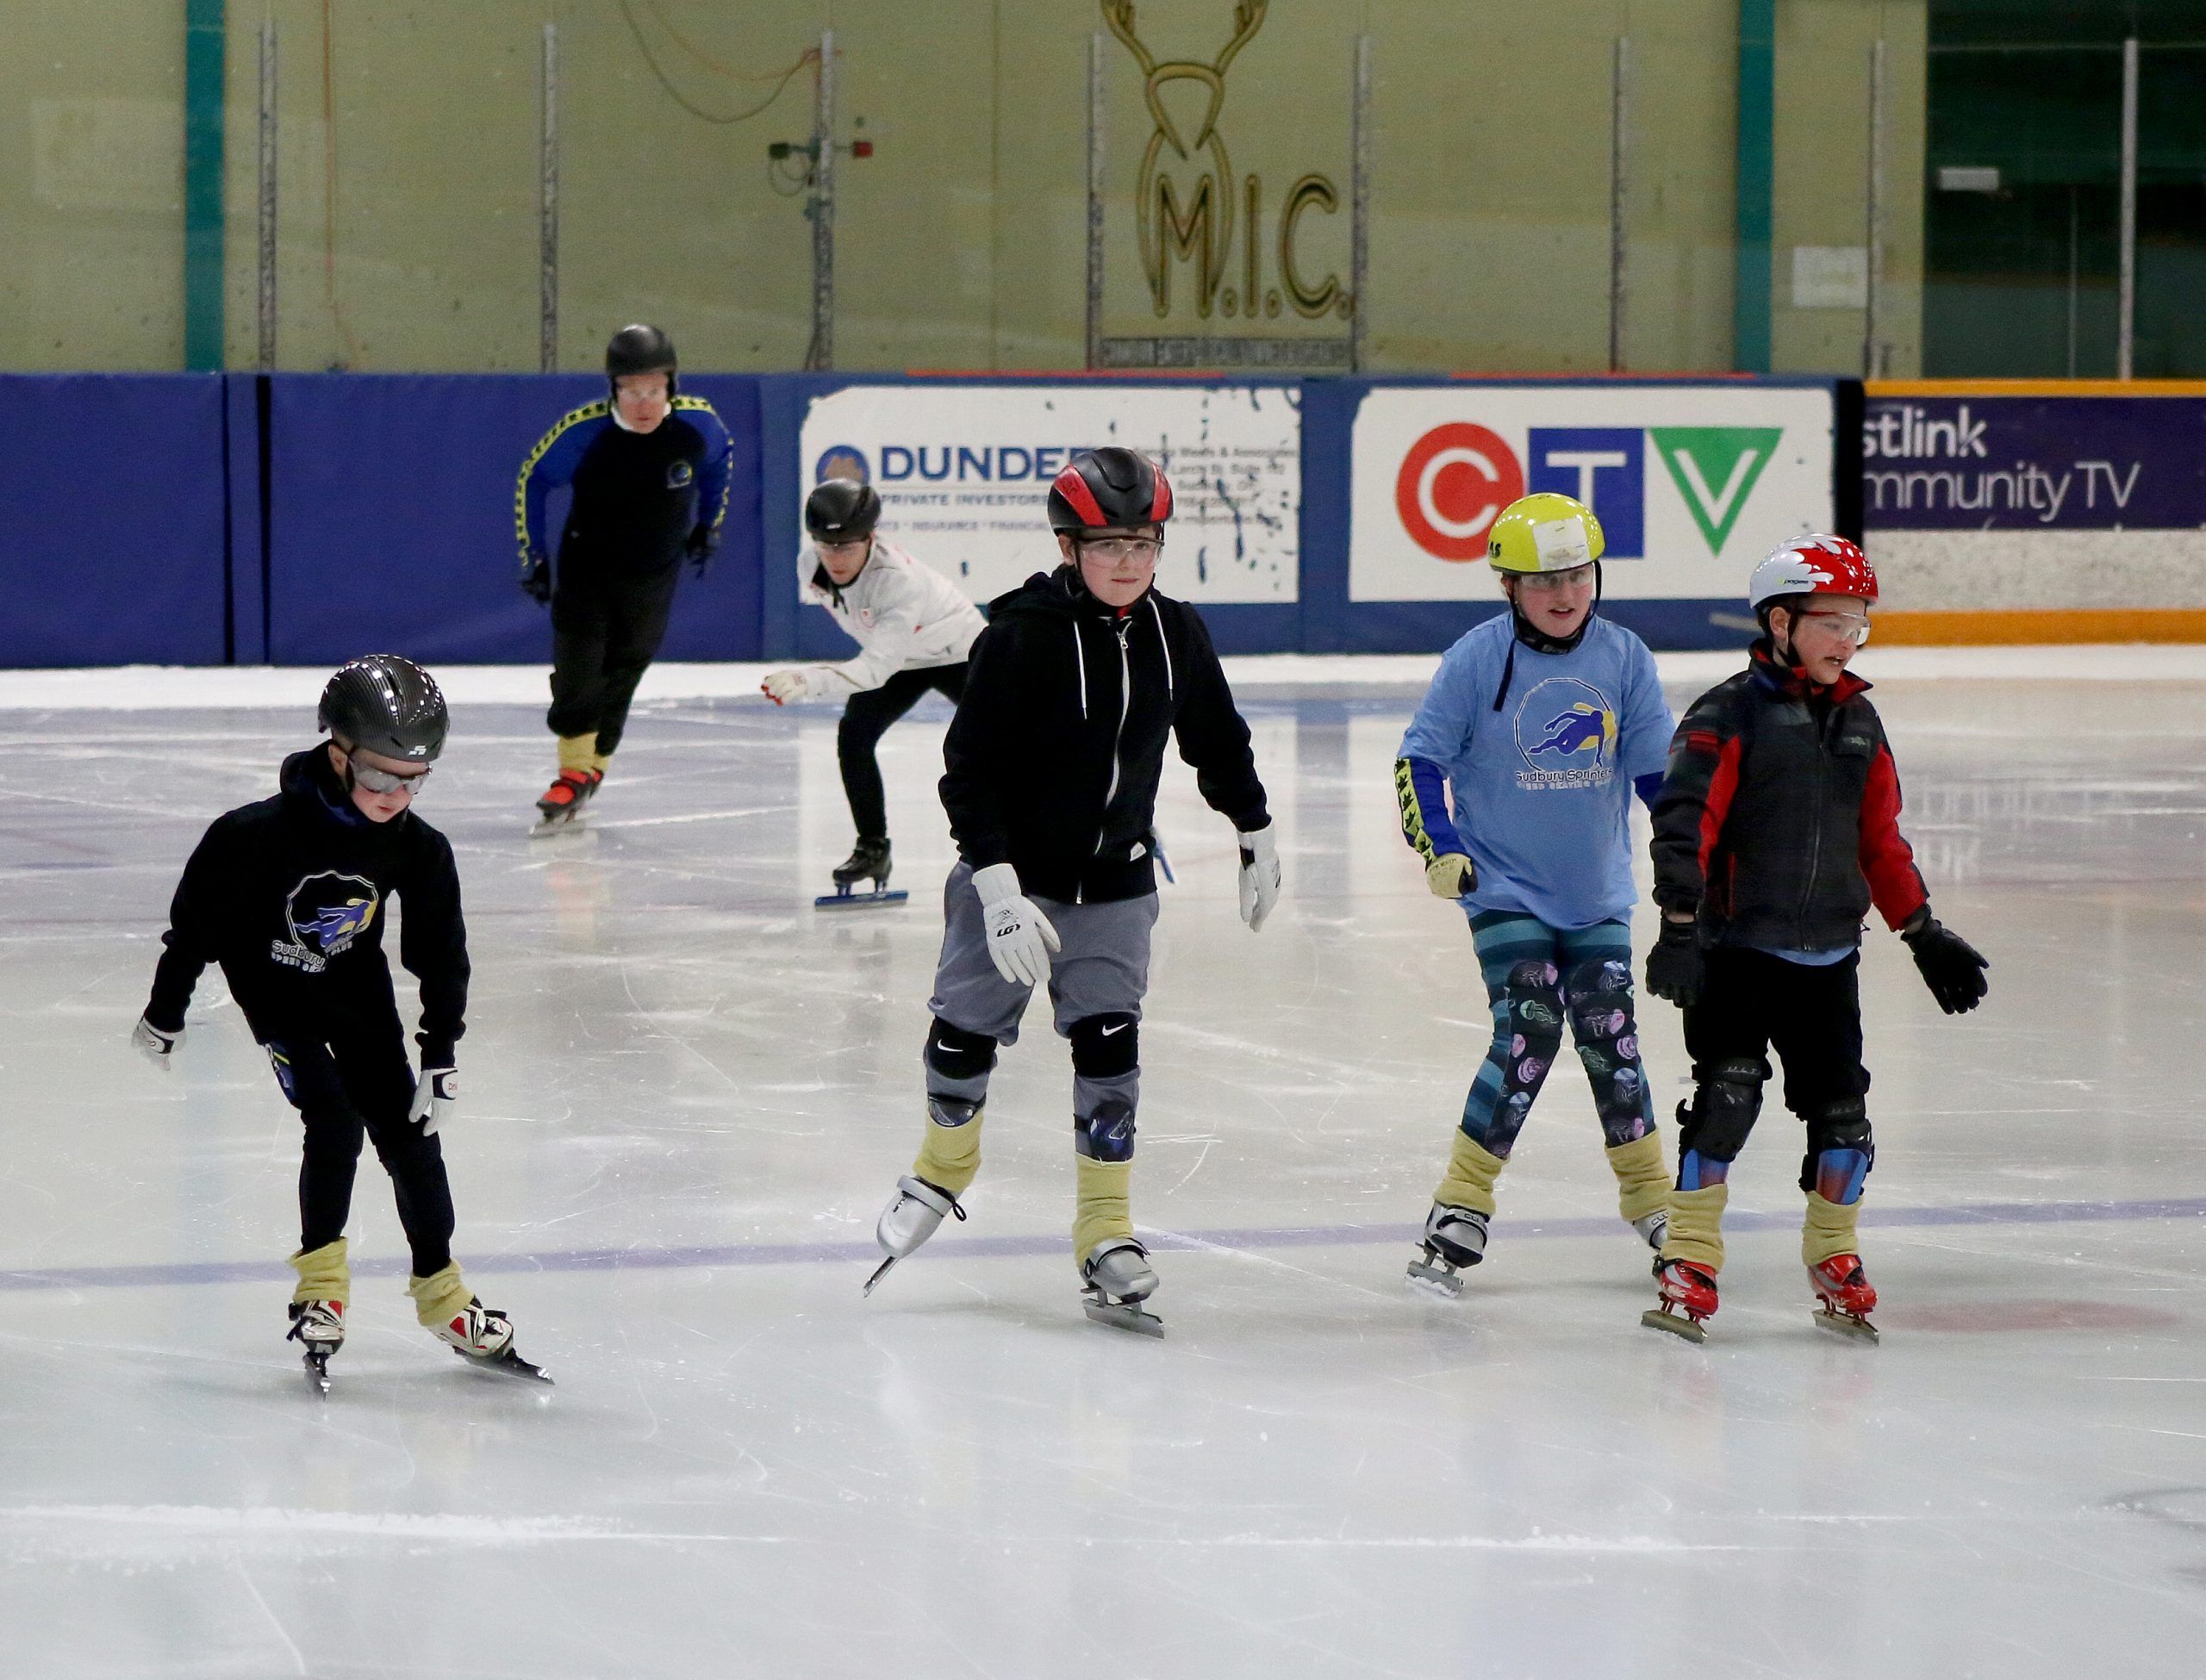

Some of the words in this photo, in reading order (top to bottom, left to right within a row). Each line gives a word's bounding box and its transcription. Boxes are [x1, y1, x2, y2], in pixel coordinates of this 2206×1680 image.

[881, 446, 1098, 482] DUNDE
[881, 494, 949, 507] PRIVATE
[1415, 445, 1761, 541] CTV
[1863, 460, 2072, 522] mmunity
[2074, 461, 2141, 509] TV
[1515, 768, 1566, 783] Sudbury
[271, 939, 327, 968] Sudbury
